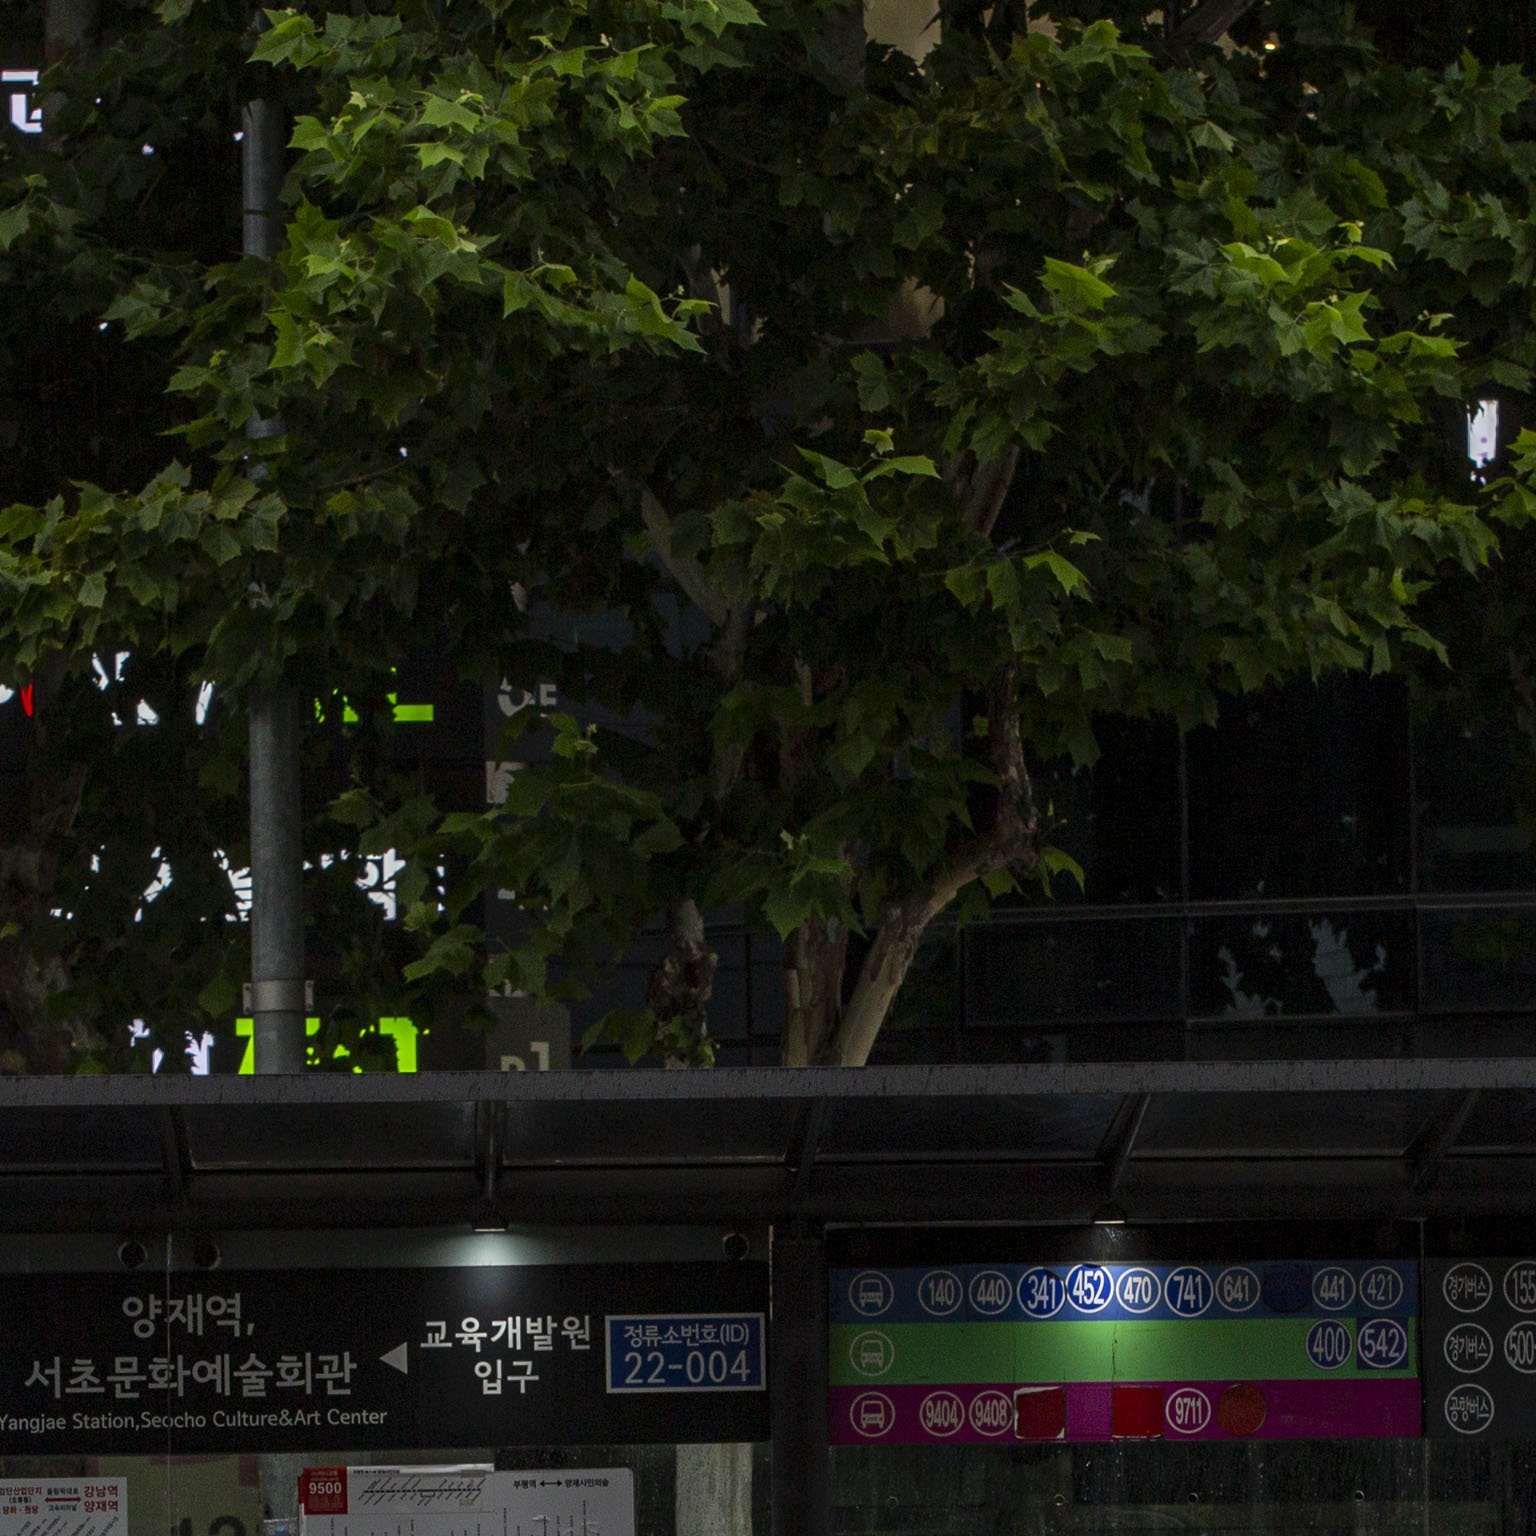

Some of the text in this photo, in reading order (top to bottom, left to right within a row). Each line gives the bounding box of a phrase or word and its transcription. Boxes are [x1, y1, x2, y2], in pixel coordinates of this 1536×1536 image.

[929, 1270, 1394, 1310] 140 440 341 452 470 741 641 441 421
[1448, 1275, 1488, 1300] 경기버스
[421, 1314, 592, 1353] 교육개발원
[624, 1323, 751, 1349] 정류소번호(ID)
[1313, 1326, 1401, 1362] 400 542
[1449, 1335, 1488, 1360] 경기버스
[24, 1351, 357, 1400] 서초문화예술회관
[474, 1360, 540, 1396] 입구
[624, 1350, 752, 1385] 22-004
[213, 1408, 321, 1429] Culture&Art
[327, 1406, 388, 1428] Center
[925, 1397, 1203, 1427] 9404 9408 9711
[1449, 1395, 1490, 1422] 공항버스
[83, 1486, 119, 1498] 강남역
[308, 1481, 342, 1495] 9500
[83, 1499, 119, 1513] 양재역
